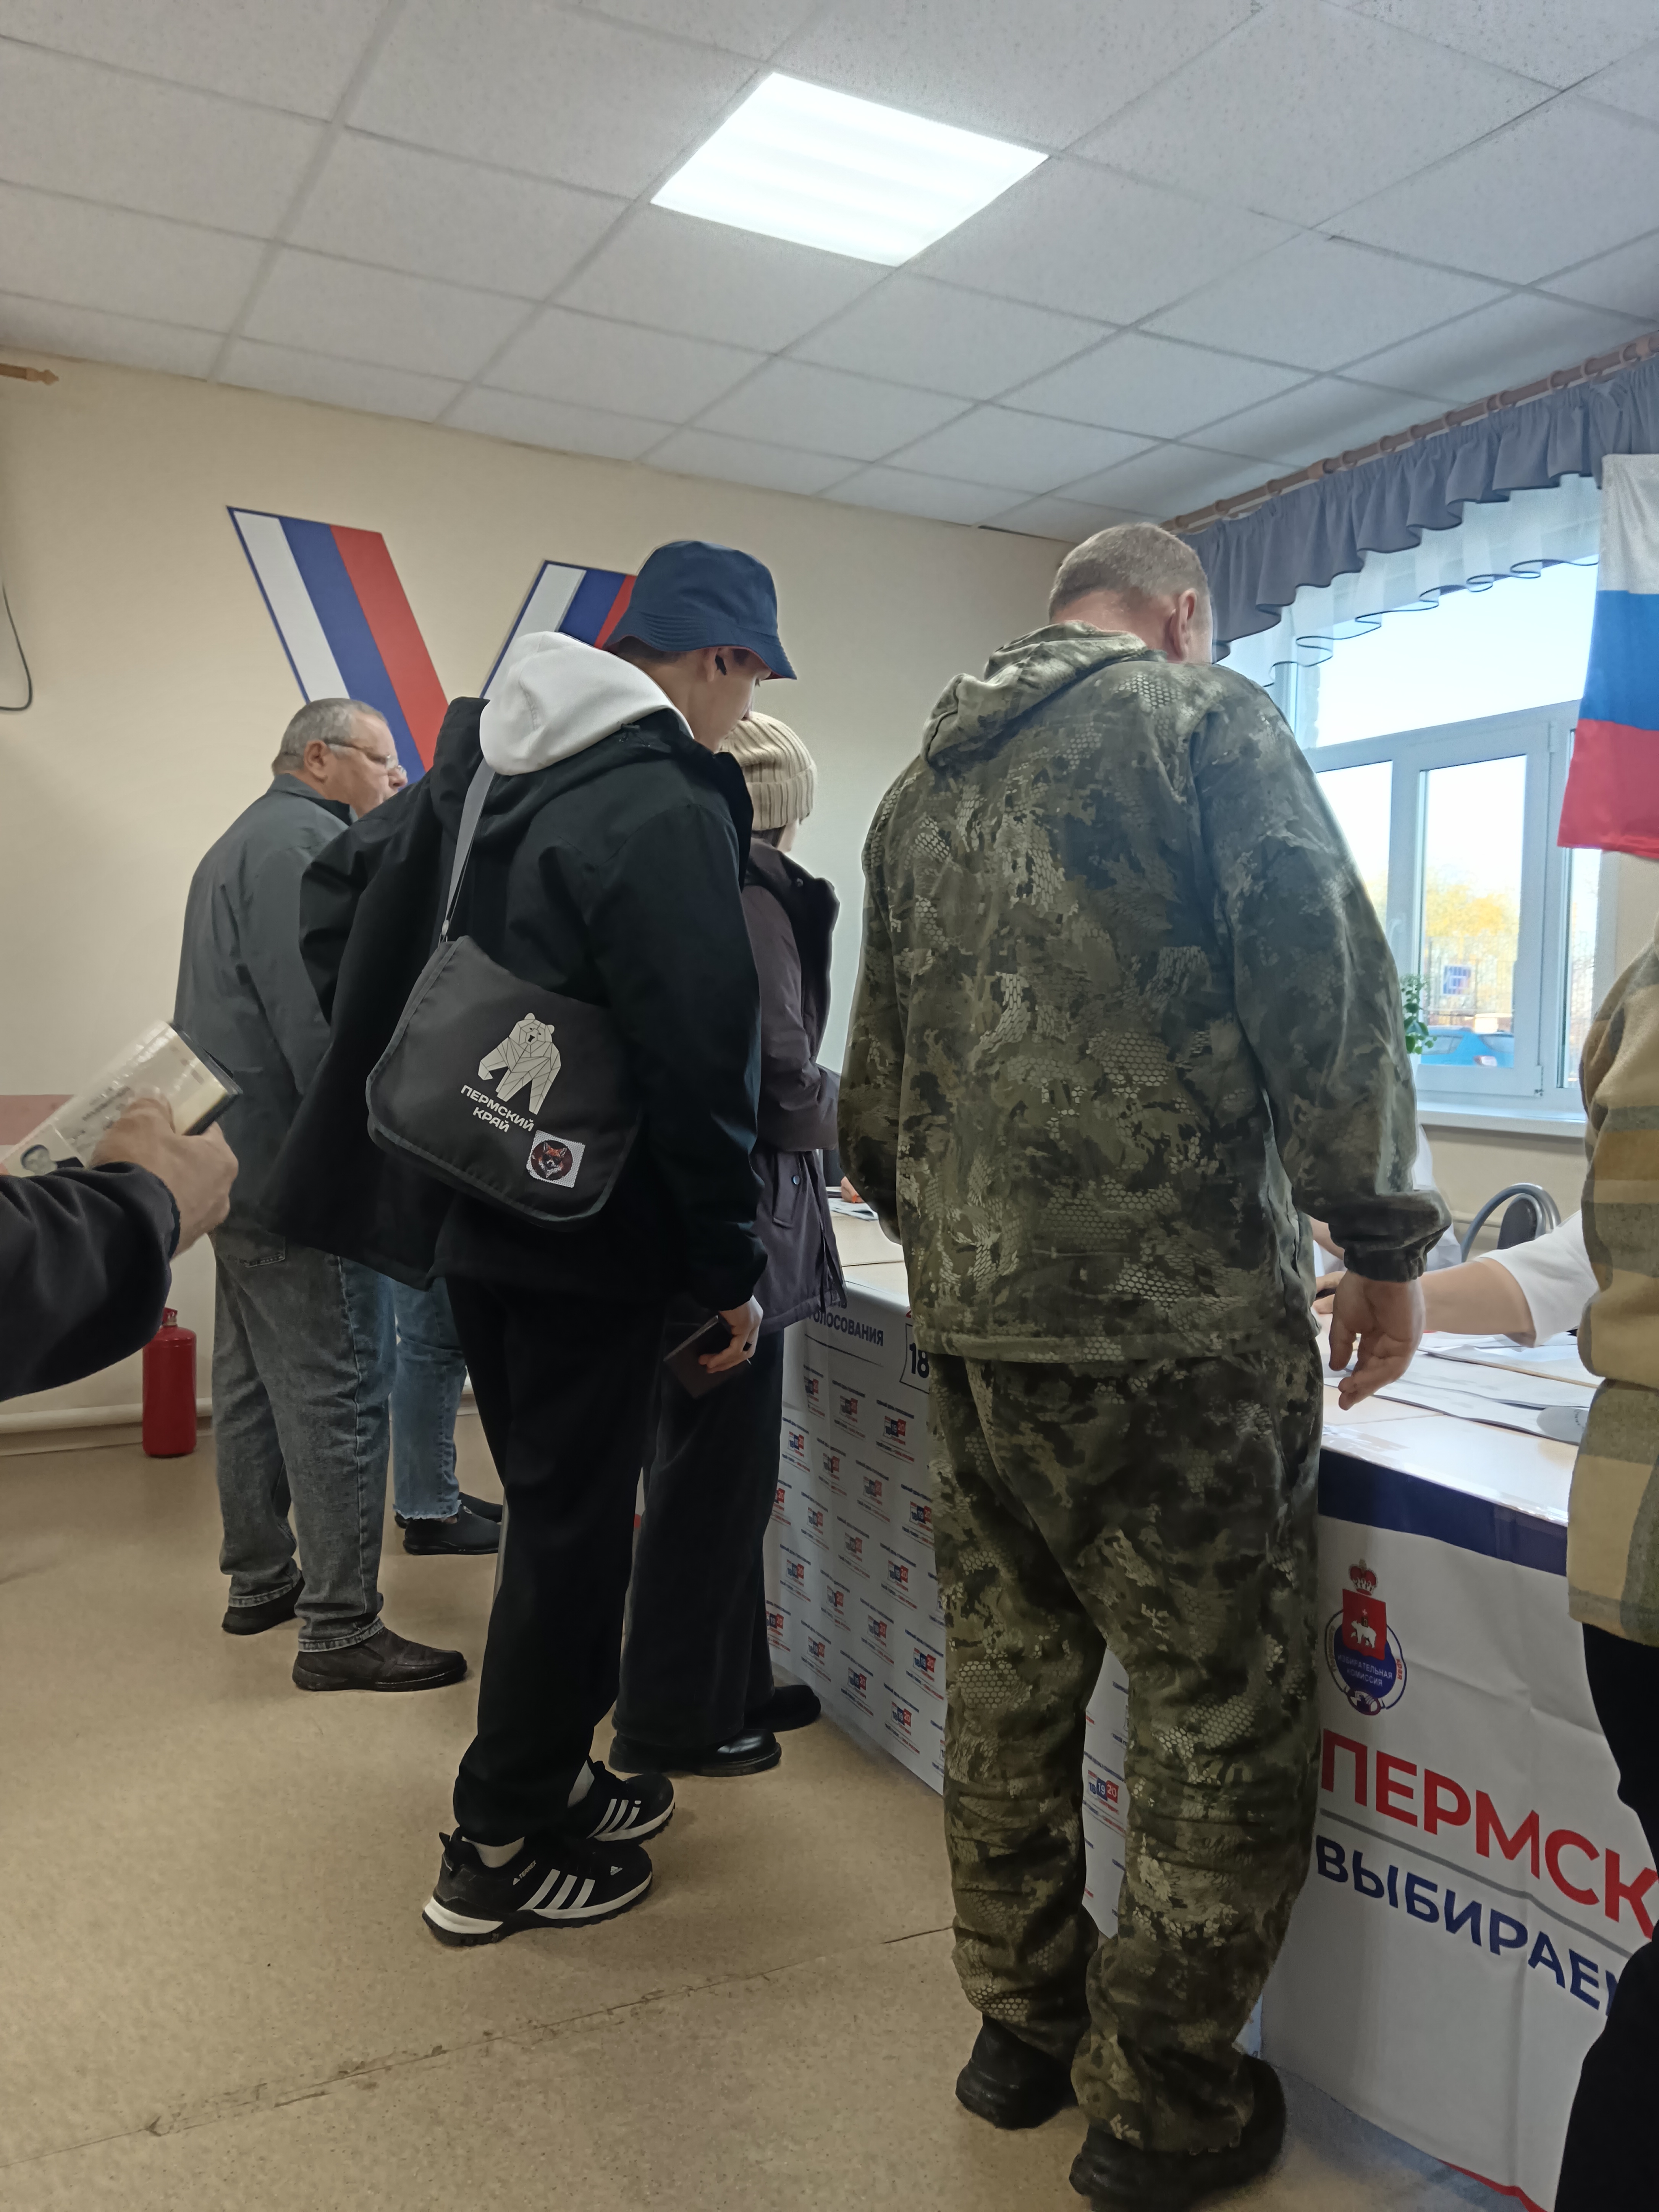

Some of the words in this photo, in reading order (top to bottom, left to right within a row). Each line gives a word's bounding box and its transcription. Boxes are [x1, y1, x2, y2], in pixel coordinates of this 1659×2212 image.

[461, 1085, 534, 1132] ПЕРМСКИЙ
[472, 1107, 510, 1132] КРАЙ
[909, 1342, 930, 1378] 18
[901, 1568, 907, 1579] 20
[880, 1624, 886, 1634] 20
[1337, 1654, 1393, 1680] ИЗБИРАТЕЛЬНАЯ
[859, 1677, 865, 1686] 20
[1347, 1668, 1383, 1687] КОМИССИЯ
[904, 1712, 910, 1722] 20
[1098, 1783, 1106, 1795] 19
[1107, 1784, 1117, 1798] 20
[1321, 1728, 1659, 1940] ПЕРМСК
